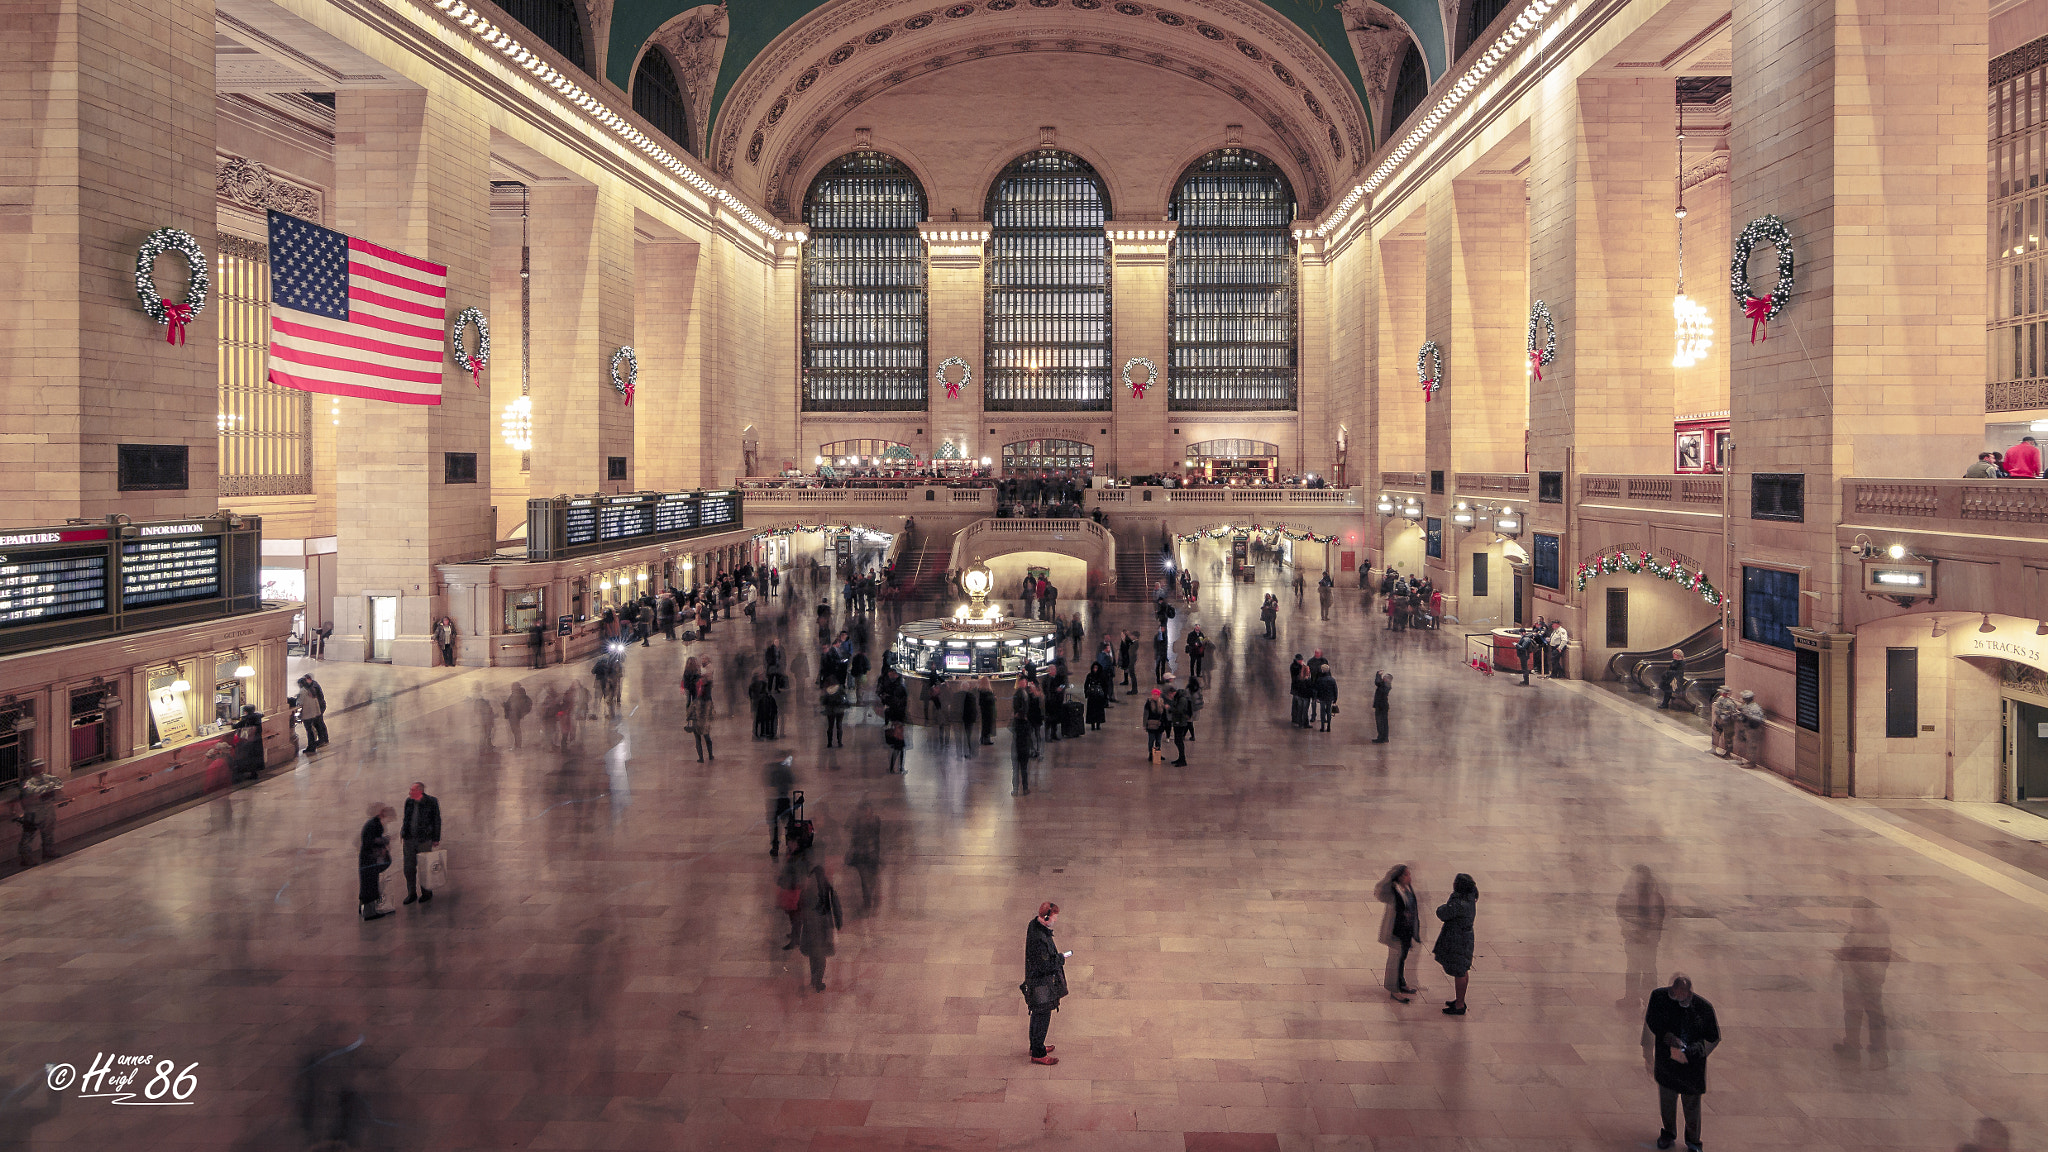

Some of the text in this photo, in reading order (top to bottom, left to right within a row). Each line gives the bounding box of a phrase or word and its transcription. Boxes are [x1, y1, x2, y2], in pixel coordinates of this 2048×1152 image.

[141, 524, 203, 536] INFORMATION
[141, 542, 170, 551] Attention
[1616, 541, 1641, 552] BUILDING
[122, 548, 216, 563] Never leave packages unattended
[1659, 546, 1700, 571] 45TH STREET
[2, 565, 19, 574] STOP
[122, 563, 156, 573] Unattended
[157, 562, 173, 570] items
[174, 560, 185, 568] may
[195, 557, 216, 566] removed
[6, 575, 39, 586] 1ST STOP
[139, 573, 149, 582] the
[163, 570, 182, 579] Police
[183, 567, 213, 577] Department
[23, 586, 35, 595] 1ST
[37, 584, 55, 593] STOP
[125, 577, 216, 593] Thank you for your cooperation
[23, 597, 35, 606] 1ST
[37, 595, 55, 604] STOP
[10, 607, 43, 619] 1ST STOP
[1974, 639, 2040, 661] 26 TRACKS 25
